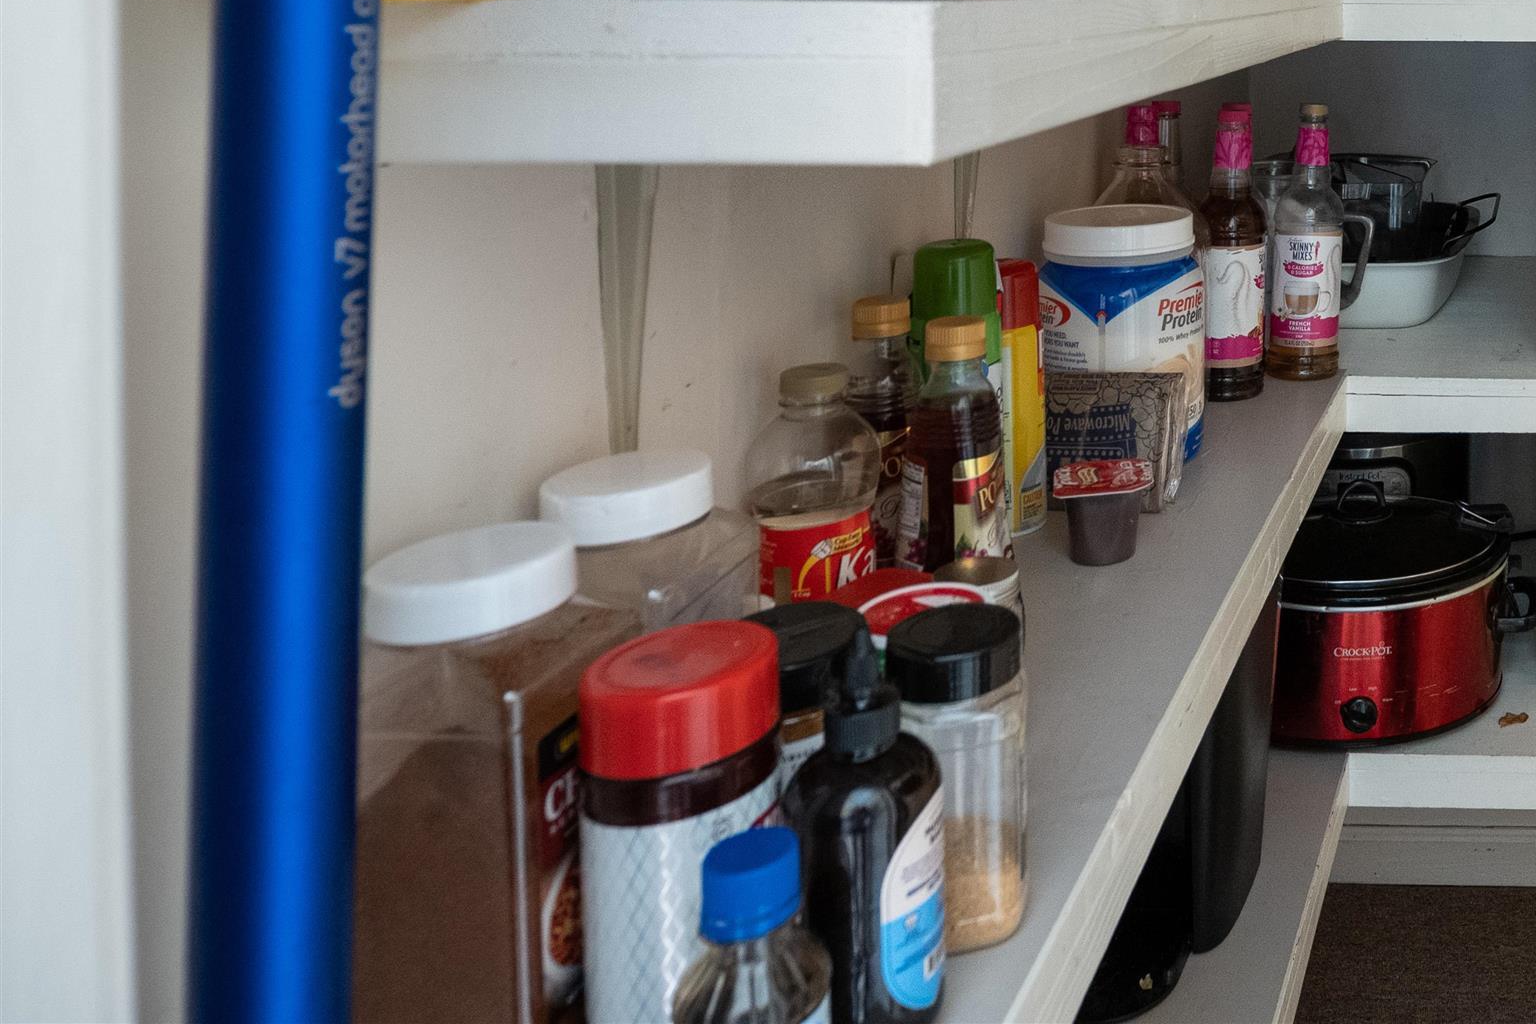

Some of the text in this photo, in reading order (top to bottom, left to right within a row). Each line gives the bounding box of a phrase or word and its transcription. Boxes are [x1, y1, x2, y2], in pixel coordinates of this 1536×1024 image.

[337, 23, 376, 233] motorhead
[1289, 241, 1314, 251] SKINNY
[1292, 251, 1313, 261] MIXES
[1039, 300, 1057, 314] mier
[1157, 289, 1203, 316] Premie
[327, 288, 367, 410] dyson
[1064, 413, 1130, 433] Microwave
[836, 544, 877, 590] Ka
